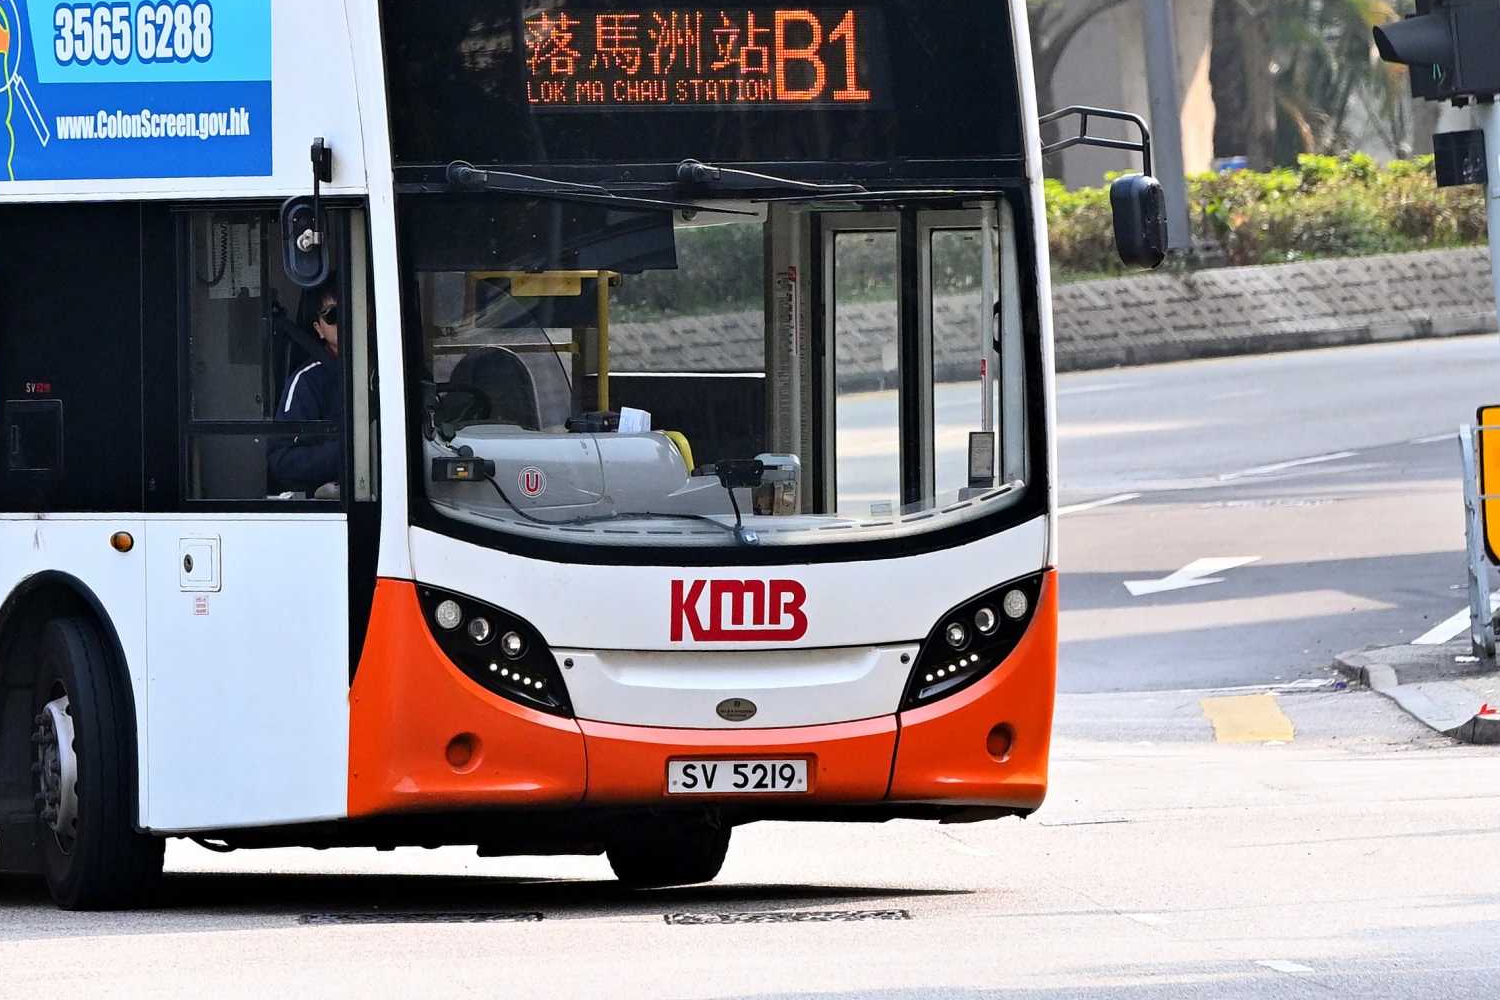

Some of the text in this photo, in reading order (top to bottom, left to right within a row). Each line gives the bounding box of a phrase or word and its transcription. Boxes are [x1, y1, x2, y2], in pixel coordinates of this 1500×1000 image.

[54, 0, 213, 65] 3565 6288
[525, 9, 872, 101] 落馬洲站 B1
[526, 79, 773, 103] LOK MA CHAU STATION
[56, 107, 251, 141] www.ColonScreen.gov.hk
[670, 579, 809, 642] KMB
[681, 763, 796, 789] SV 5219
